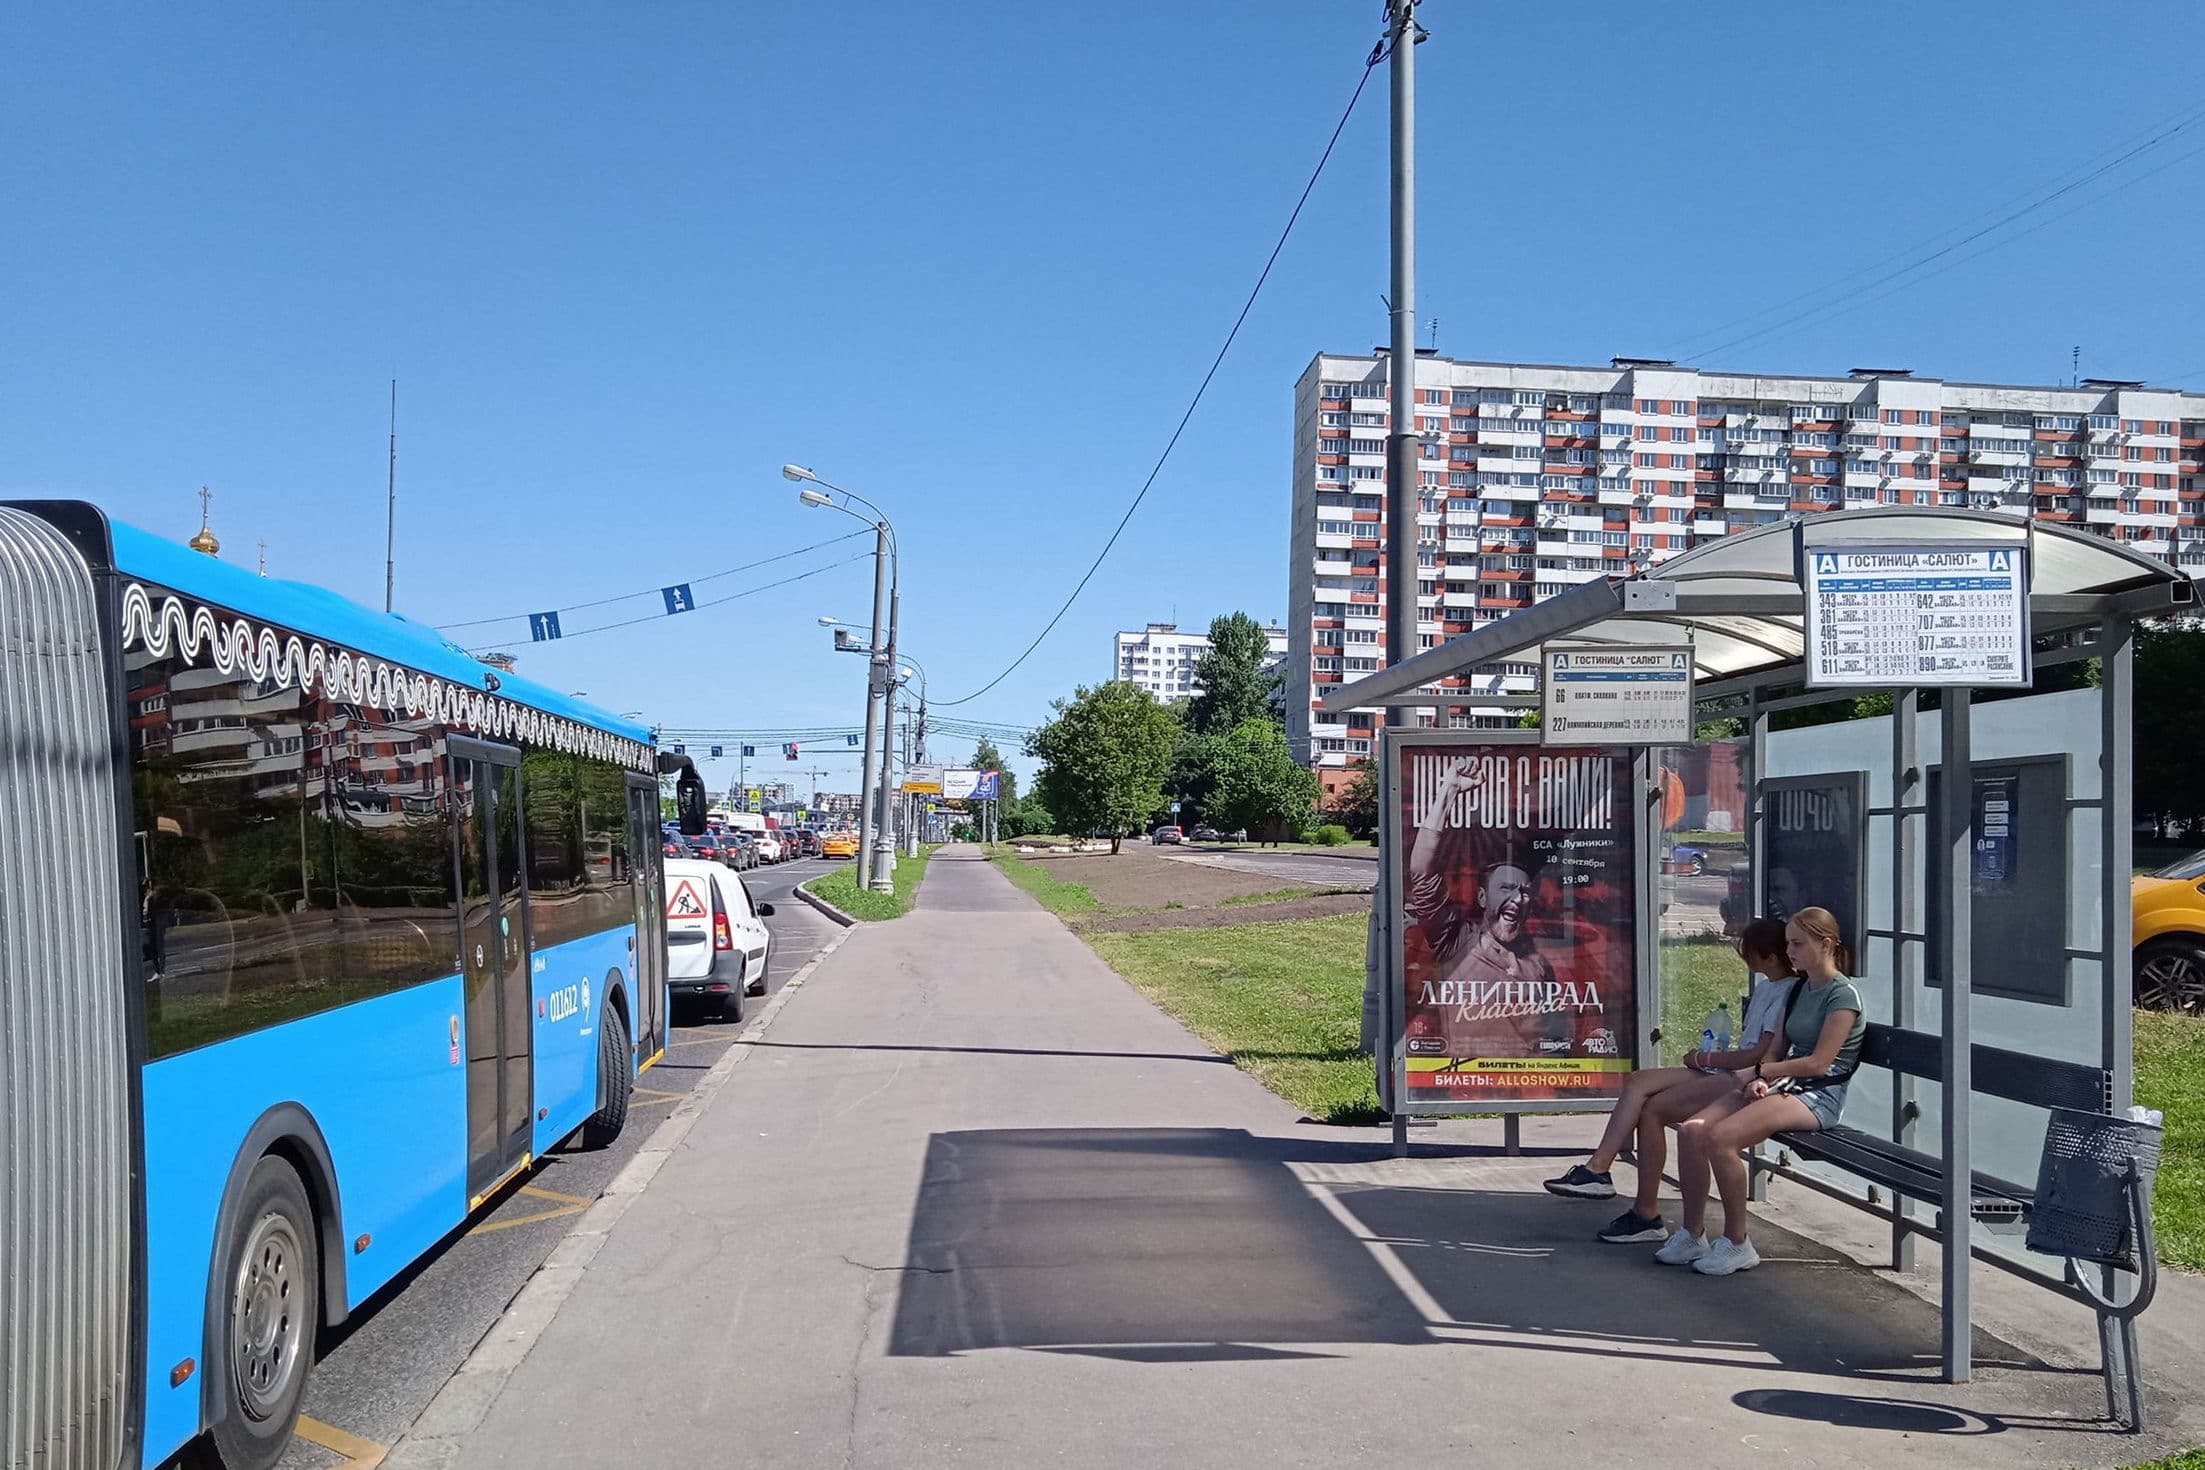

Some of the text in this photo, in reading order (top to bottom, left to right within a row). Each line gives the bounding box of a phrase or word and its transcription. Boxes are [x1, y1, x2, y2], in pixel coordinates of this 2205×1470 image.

[1847, 554, 1978, 568] ГОСТИНИЦА «САЛЮТ»
[1819, 593, 1836, 608] 343
[1917, 594, 1934, 609] 642
[1820, 609, 1836, 624] 361
[1918, 614, 1934, 629] 707
[1821, 625, 1838, 640] 485
[1821, 641, 1838, 656] 518
[1919, 635, 1934, 650] 877
[1575, 656, 1624, 665] ГОСТИНИЦА
[1822, 659, 1838, 674] 611
[1920, 656, 1936, 671] 890
[1556, 689, 1565, 703] 66
[1553, 717, 1567, 731] 227
[1517, 756, 1530, 829] С
[1538, 756, 1612, 829] ВАМИ!
[1533, 838, 1614, 850] БСА «Лужники»
[1547, 855, 1605, 867] 10 сентября
[1562, 874, 1589, 884] 19:00
[550, 984, 578, 1023] 011612
[1417, 980, 1604, 1014] ЛЕНИНГРАД
[1455, 997, 1567, 1023] Классика
[1478, 1061, 1526, 1069] БИЛЕТЫ
[1435, 1074, 1590, 1086] БИЛЕТЫ: ALLOSHOW.RU
